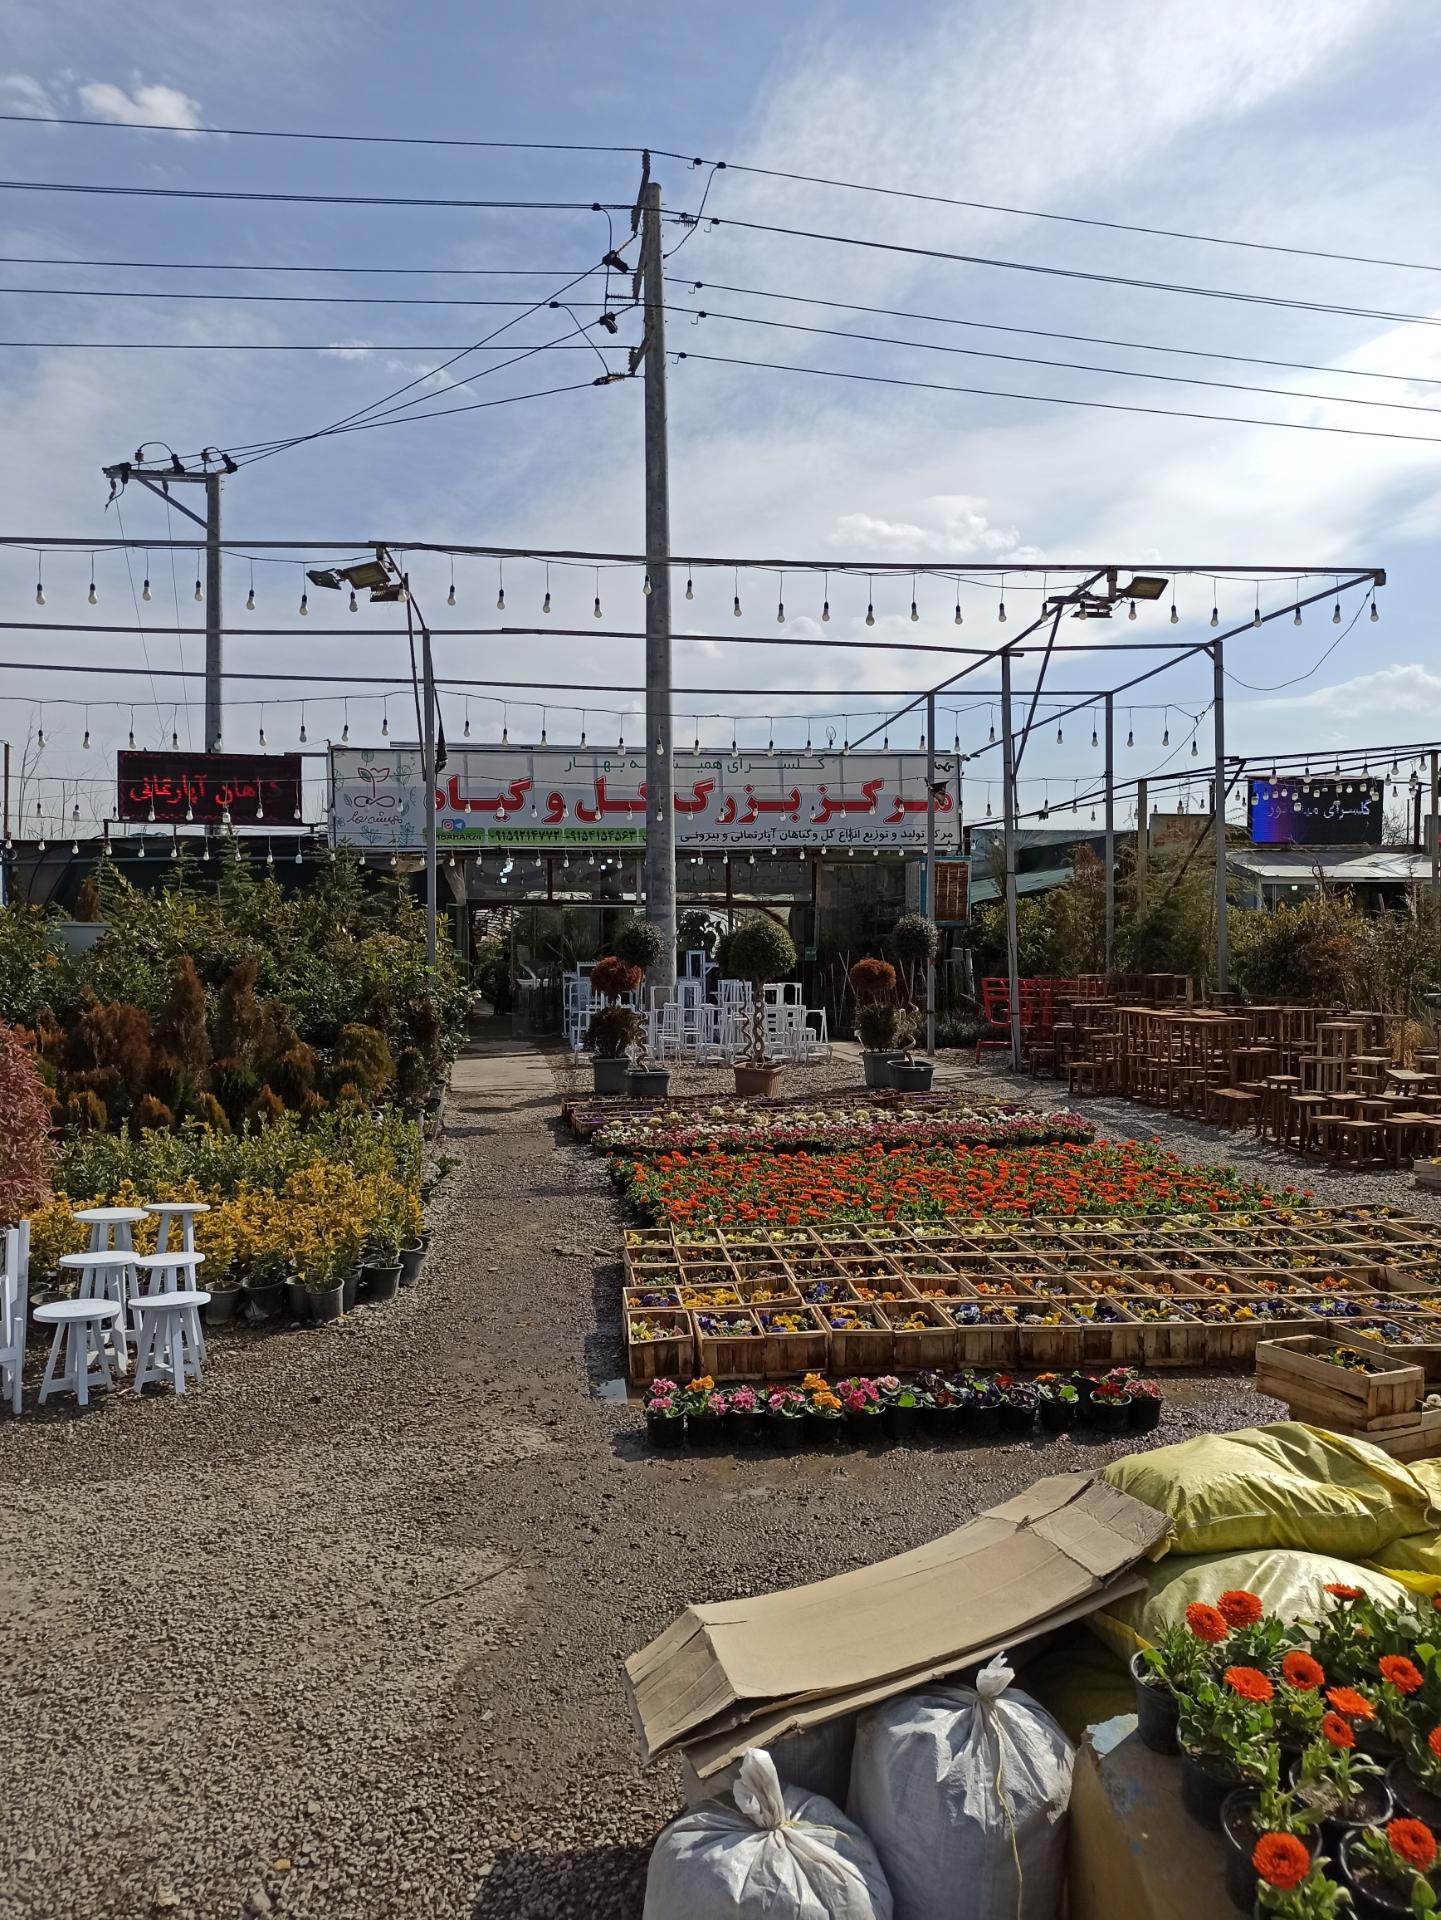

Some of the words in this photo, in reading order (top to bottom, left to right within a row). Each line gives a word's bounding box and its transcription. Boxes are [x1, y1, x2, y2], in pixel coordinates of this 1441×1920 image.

[564, 756, 625, 773] بهار
[424, 774, 534, 823] گیاه
[673, 777, 802, 825] بزرگ
[810, 777, 954, 825] مرکز
[541, 790, 565, 825] و
[680, 830, 720, 842] بیرونی
[722, 832, 728, 841] و
[731, 828, 776, 843] آپارتمانی
[779, 828, 811, 841] گیاهان
[821, 828, 836, 842] گل
[838, 828, 861, 843] انواع
[863, 829, 889, 843] توزیع
[891, 832, 897, 841] و
[901, 829, 925, 841] تولید
[931, 829, 953, 841] مرک
